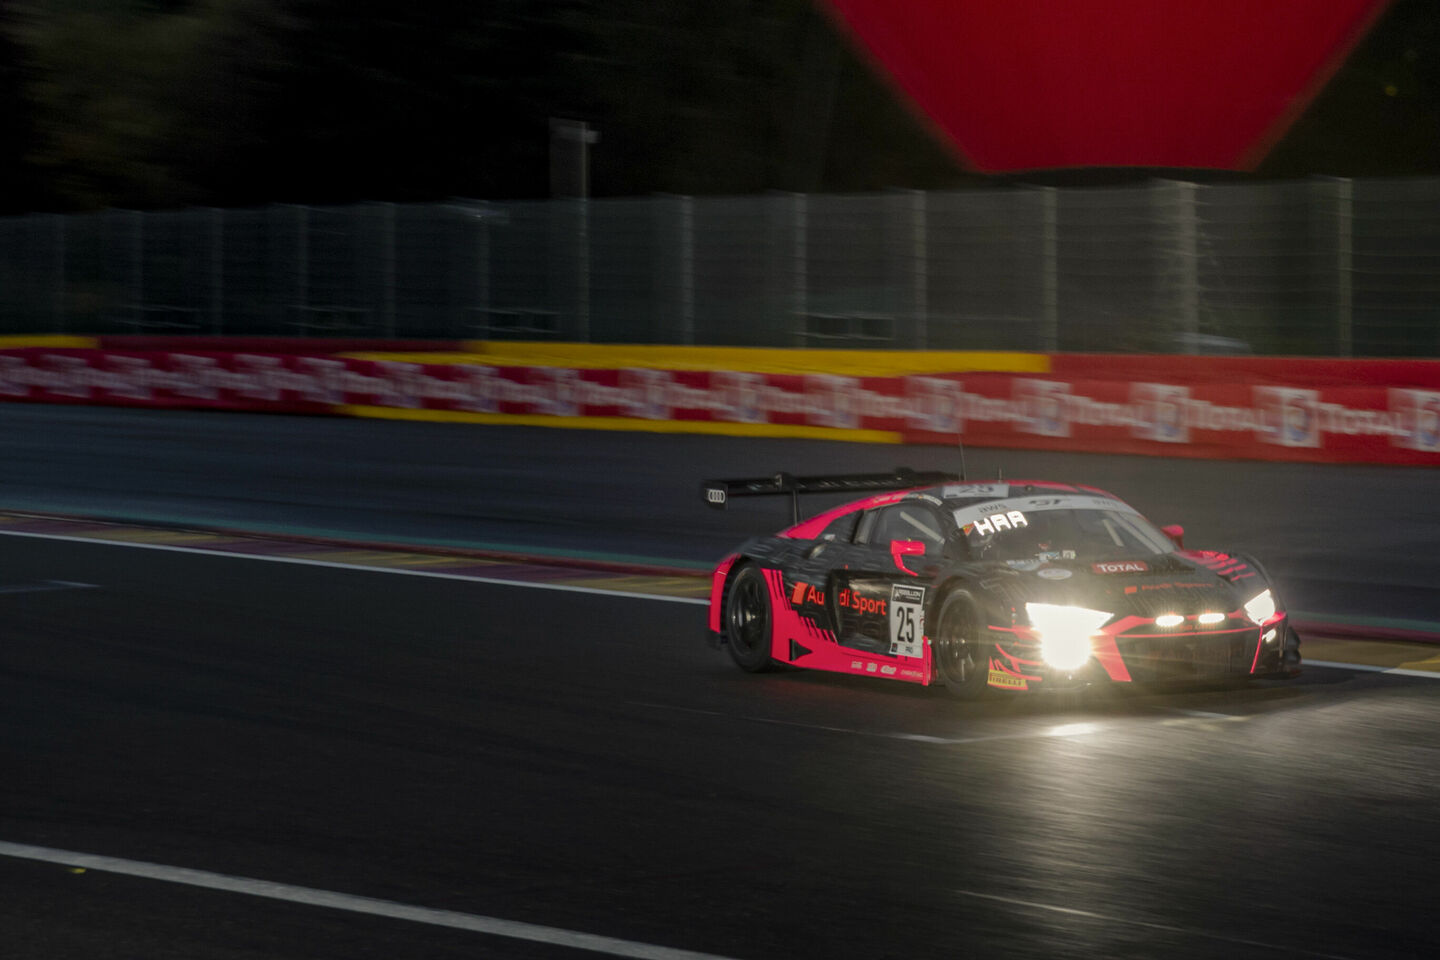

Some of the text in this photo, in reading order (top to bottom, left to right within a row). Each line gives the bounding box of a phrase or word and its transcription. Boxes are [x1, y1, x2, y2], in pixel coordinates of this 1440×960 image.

[973, 510, 1029, 536] HAA
[1096, 562, 1145, 573] TOTAL
[806, 584, 887, 616] Audi Sport
[896, 605, 915, 644] 25
